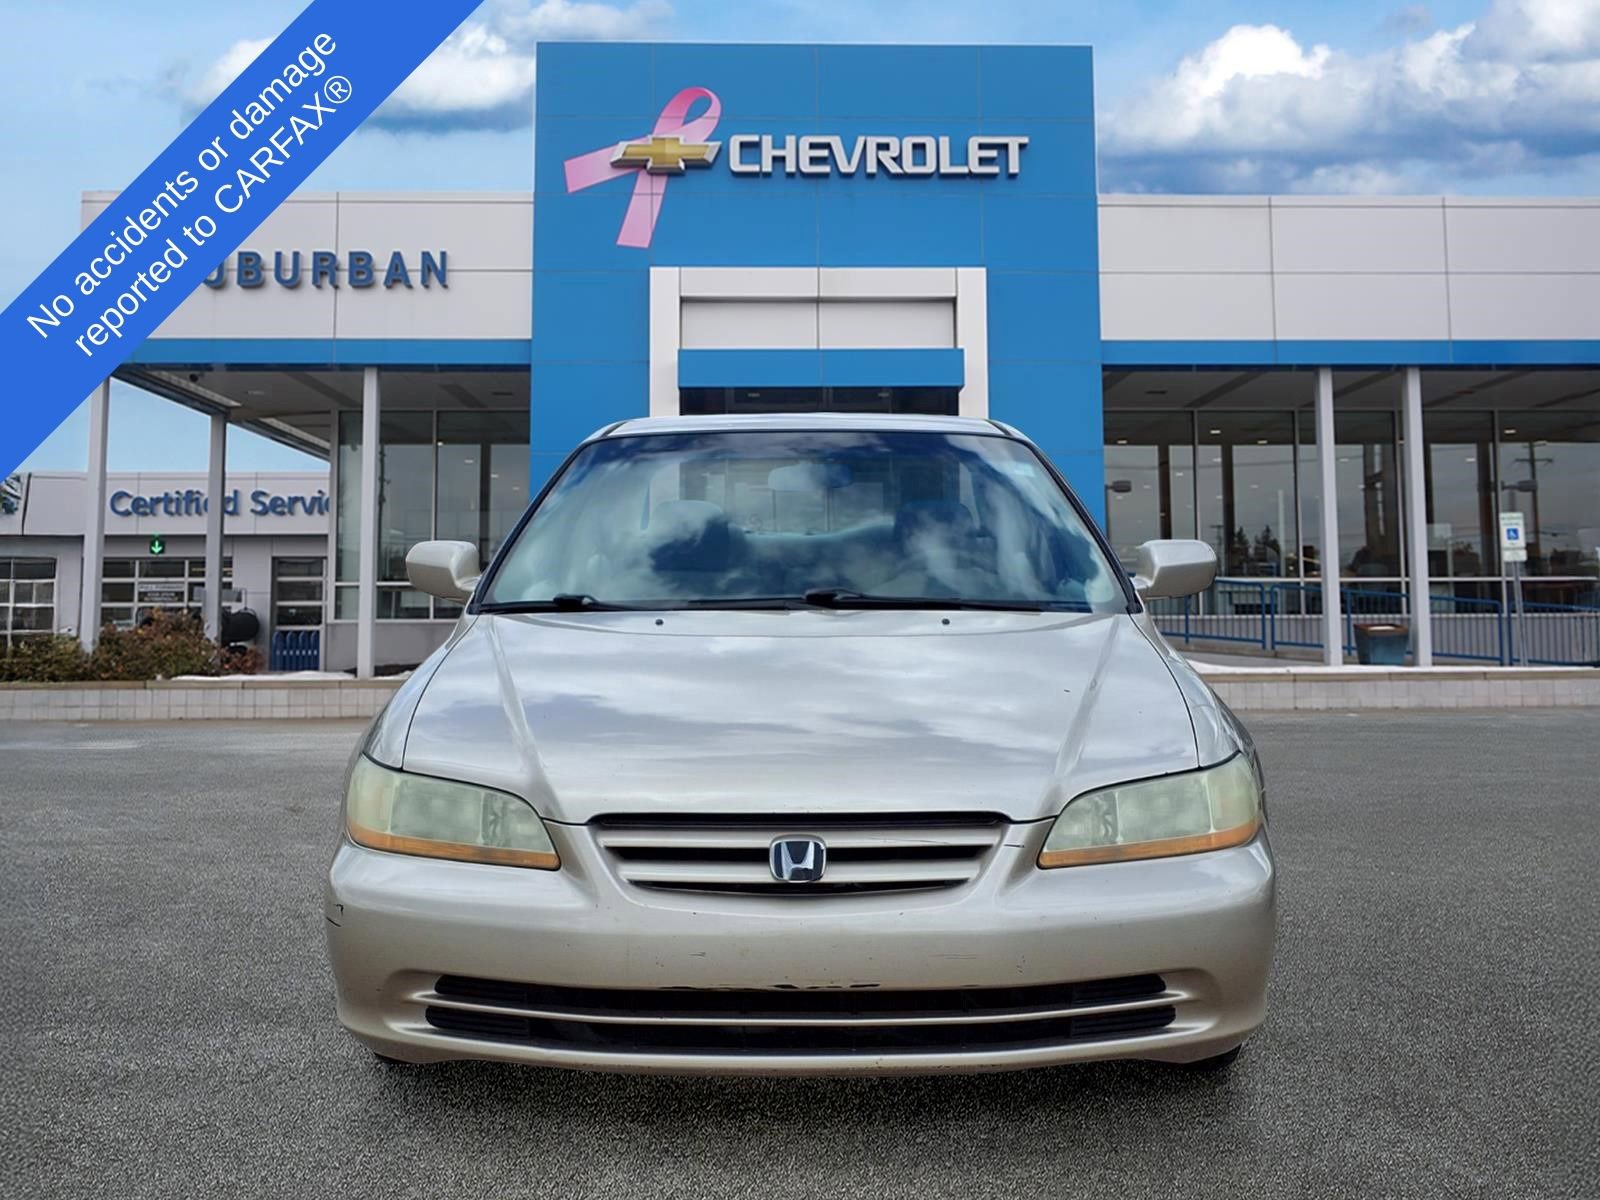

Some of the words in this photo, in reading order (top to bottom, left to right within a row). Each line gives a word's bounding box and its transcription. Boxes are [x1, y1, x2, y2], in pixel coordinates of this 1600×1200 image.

[728, 134, 1029, 175] CHEVROLET
[203, 250, 448, 289] UBURBAN
[250, 489, 329, 516] Servi
